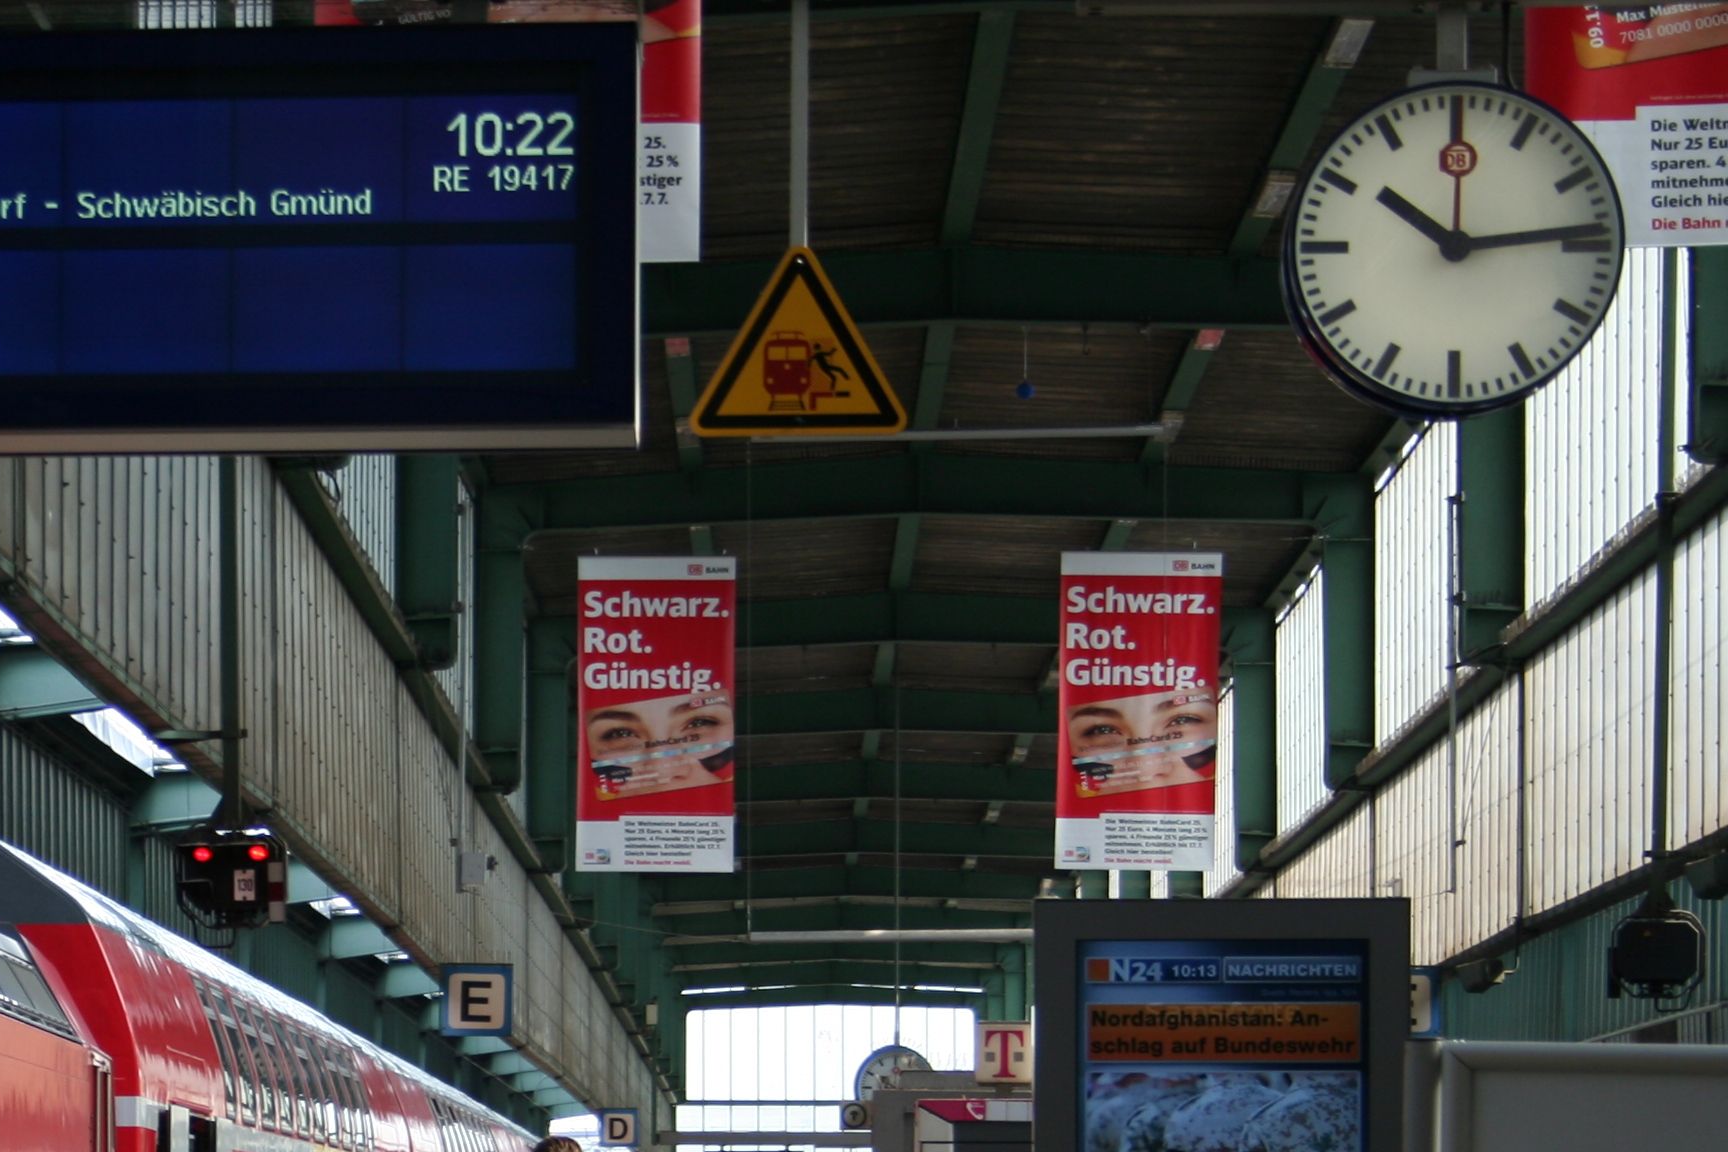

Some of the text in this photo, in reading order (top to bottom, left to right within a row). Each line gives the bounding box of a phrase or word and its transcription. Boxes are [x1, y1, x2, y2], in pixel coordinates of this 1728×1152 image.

[1616, 9, 1646, 23] Max
[1618, 27, 1654, 44] 7081
[1657, 19, 1692, 37] 0000
[447, 111, 575, 157] 10:22
[1650, 119, 1677, 132] Die
[644, 136, 666, 149] 25.
[1650, 138, 1681, 151] Nur
[1685, 137, 1703, 150] 25
[1650, 155, 1727, 173] sparen. 4
[433, 164, 574, 193] RE 19417
[639, 175, 683, 189] stiger
[77, 190, 257, 220] Schwäbisch
[270, 188, 372, 216] Gmünd
[1651, 193, 1703, 208] Gleich
[1651, 217, 1721, 231] Die Bahn
[706, 566, 730, 574] BAHN
[1191, 562, 1215, 570] BAHN
[584, 590, 730, 618] Schwarz.
[1066, 585, 1215, 614] Schwarz.
[583, 627, 653, 654] Rot.
[1066, 622, 1136, 650] Rot.
[583, 661, 722, 694] Günstig.
[1065, 658, 1206, 691] Günstig.
[237, 879, 253, 892] 130
[1111, 957, 1357, 982] N24 10:13 NACHRICHTEN
[460, 980, 493, 1023] E
[1091, 1009, 1329, 1030] Nordafghanistan: An-
[984, 1029, 1025, 1079] T
[1091, 1036, 1357, 1058] schlag auf Bundeswehr
[609, 1118, 628, 1140] D
